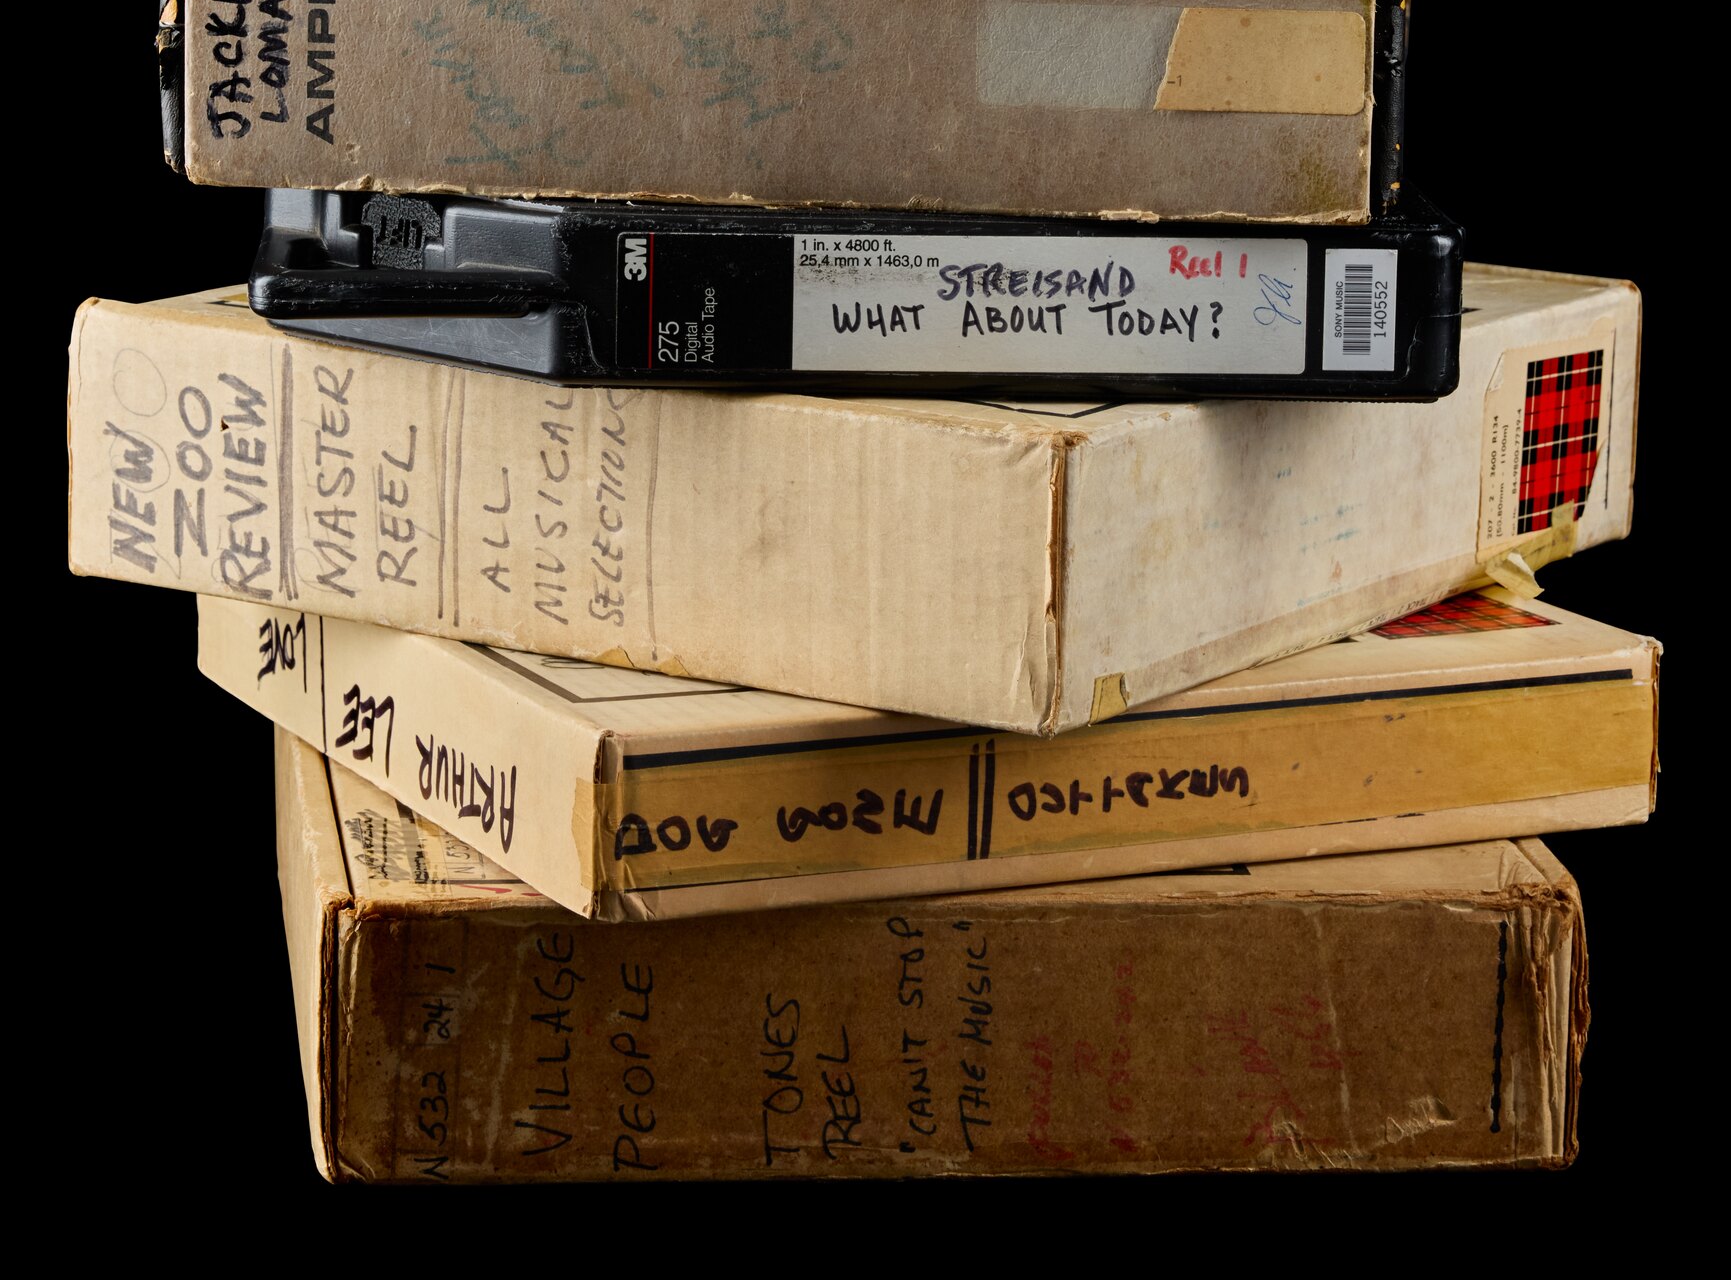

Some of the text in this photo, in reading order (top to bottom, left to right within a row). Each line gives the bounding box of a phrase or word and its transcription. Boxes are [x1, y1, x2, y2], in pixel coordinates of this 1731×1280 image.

[624, 238, 647, 282] 3M
[799, 254, 940, 270] 25,4 mm x 1463,0 m
[801, 238, 897, 252] 1 in. x 4800 ft.
[936, 260, 1137, 302] STREISAND
[1168, 244, 1248, 280] Reel 1
[657, 320, 680, 363] 275
[684, 321, 698, 363] Digital
[701, 287, 716, 363] Audio Tape
[831, 302, 926, 338] WHAT
[960, 300, 1068, 338] ABOUT
[1087, 298, 1224, 343] TODAY?
[1334, 280, 1344, 338] SONY MUSIC
[1373, 280, 1389, 339] 140552
[103, 420, 158, 574] NEW
[173, 385, 213, 558] ZOO
[218, 371, 275, 600] REVIEW
[315, 362, 357, 600] MASTER
[376, 424, 418, 587] REEL
[534, 386, 575, 626] MUSICAL
[480, 466, 511, 593] ALL
[257, 612, 308, 694] LOVE
[335, 681, 395, 778] LEE
[415, 731, 518, 855] ARTHUR
[614, 763, 1249, 862] DOG GONE OUTTAKES
[885, 916, 925, 1011] STOP
[420, 998, 454, 1040] 24
[517, 931, 587, 1157] VILLAGE
[416, 1070, 450, 1148] 532
[612, 961, 659, 1172] PEOPLE
[761, 993, 803, 1168] TONES
[821, 1024, 864, 1161] REEL
[955, 1059, 994, 1153] THE
[412, 1155, 449, 1181] N
